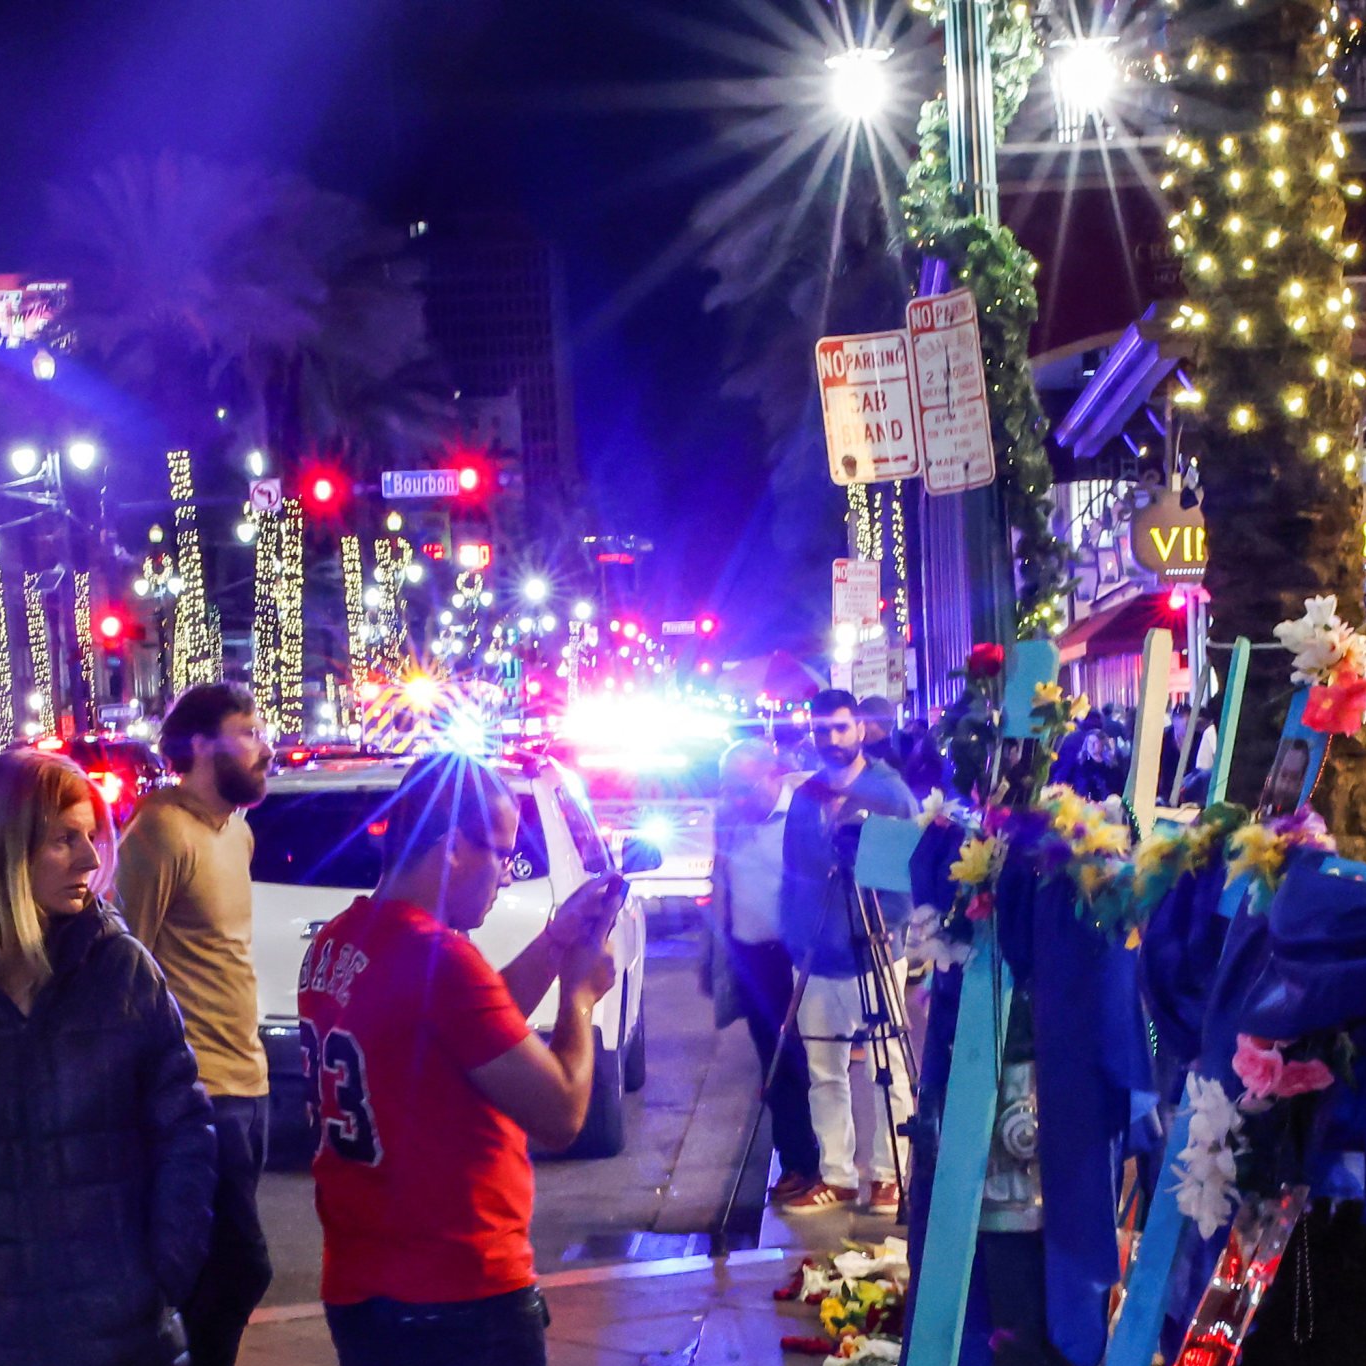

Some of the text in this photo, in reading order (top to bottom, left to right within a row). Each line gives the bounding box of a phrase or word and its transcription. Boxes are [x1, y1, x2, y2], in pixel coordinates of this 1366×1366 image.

[910, 302, 933, 330] NO
[820, 349, 846, 381] NO
[846, 347, 904, 373] PARKING
[842, 417, 904, 448] SAND
[394, 473, 455, 495] Bourbon
